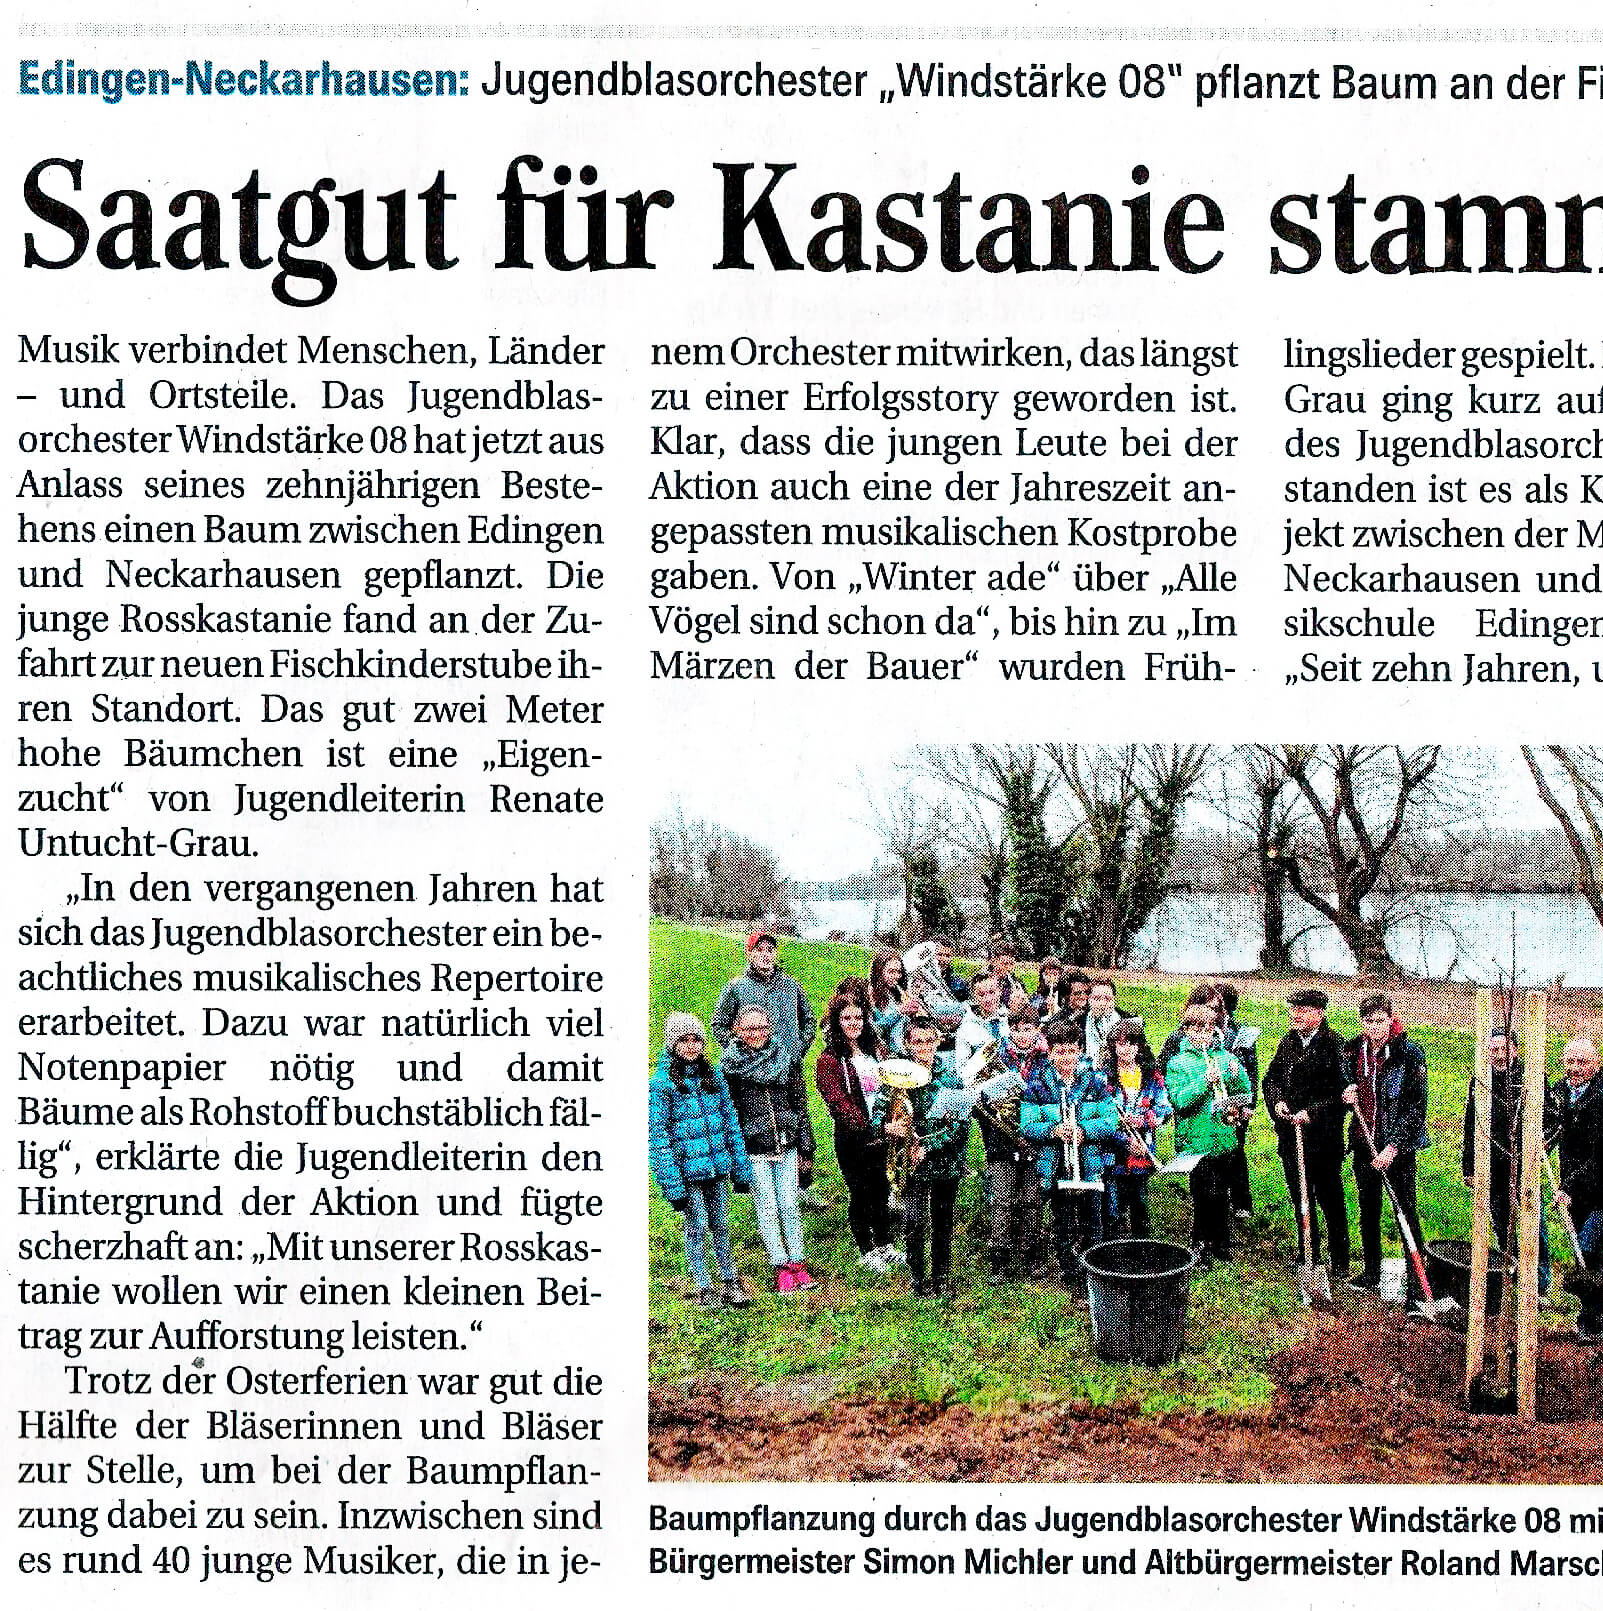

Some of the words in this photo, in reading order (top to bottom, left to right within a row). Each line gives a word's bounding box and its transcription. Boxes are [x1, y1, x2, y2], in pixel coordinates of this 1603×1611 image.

[20, 59, 468, 104] Edingen-Neckarhausen:
[482, 61, 867, 104] Jugendblasorchester
[1197, 64, 1320, 107] pflanzt
[1333, 65, 1436, 99] Baum
[1451, 74, 1492, 99] an
[1507, 65, 1565, 100] der
[24, 158, 459, 307] Saatgut
[495, 155, 674, 272] für
[713, 163, 1224, 274] Kastanie
[18, 334, 119, 363] Musik
[128, 334, 287, 363] verbindet
[298, 335, 476, 368] Menschen,
[489, 335, 605, 364] Länder
[651, 390, 690, 410] zu
[706, 382, 789, 410] einer
[804, 381, 999, 420] Erfolgsstory
[1014, 383, 1175, 420] geworden
[1191, 384, 1236, 412] ist.
[1285, 473, 1416, 503] standen
[1429, 474, 1467, 502] ist
[1480, 482, 1511, 503] es
[1526, 474, 1567, 503] als
[651, 520, 813, 553] gepassten
[822, 516, 1058, 546] musikalischen
[1068, 517, 1236, 555] Kostprobe
[18, 558, 83, 587] und
[106, 558, 341, 588] Neckarhausen
[365, 559, 522, 597] gepflanzt.
[547, 561, 603, 589] Die
[650, 651, 775, 679] Märzen
[795, 650, 848, 679] der
[999, 651, 1125, 680] wurden
[1145, 651, 1235, 681] Früh-
[1372, 652, 1452, 682] zehn
[1463, 653, 1579, 687] Jahren,
[148, 791, 211, 812] von
[234, 783, 465, 821] Jugendleiterin
[490, 784, 603, 813] Renate
[19, 961, 182, 991] achtliches
[193, 962, 421, 992] musikalisches
[431, 964, 603, 1000] Repertoire
[18, 1186, 223, 1224] Hintergrund
[242, 1186, 295, 1215] der
[310, 1186, 419, 1216] Aktion
[437, 1186, 502, 1216] und
[521, 1186, 602, 1225] fügte
[18, 1409, 116, 1439] Hälfte
[136, 1409, 189, 1439] der
[207, 1410, 402, 1439] Bläserinnen
[420, 1410, 485, 1440] und
[502, 1411, 603, 1440] Bläser
[650, 1504, 874, 1537] Baumpflanzung
[885, 1505, 966, 1531] durch
[976, 1505, 1026, 1531] das
[1035, 1505, 1342, 1538] Jugendblasorchester
[1349, 1506, 1516, 1533] Windstärke
[1525, 1507, 1560, 1533] 08
[19, 1553, 51, 1573] es
[63, 1544, 142, 1573] rund
[153, 1546, 189, 1573] 40
[200, 1545, 291, 1582] junge
[304, 1545, 443, 1579] Musiker,
[457, 1545, 505, 1574] die
[517, 1546, 549, 1574] in
[558, 1546, 600, 1583] je-
[650, 1547, 855, 1580] Bürgermeister
[864, 1547, 954, 1574] Simon
[965, 1548, 1073, 1574] Michler
[1083, 1548, 1136, 1574] und
[1145, 1549, 1392, 1581] Altbürgermeister
[1402, 1549, 1500, 1576] Roland
